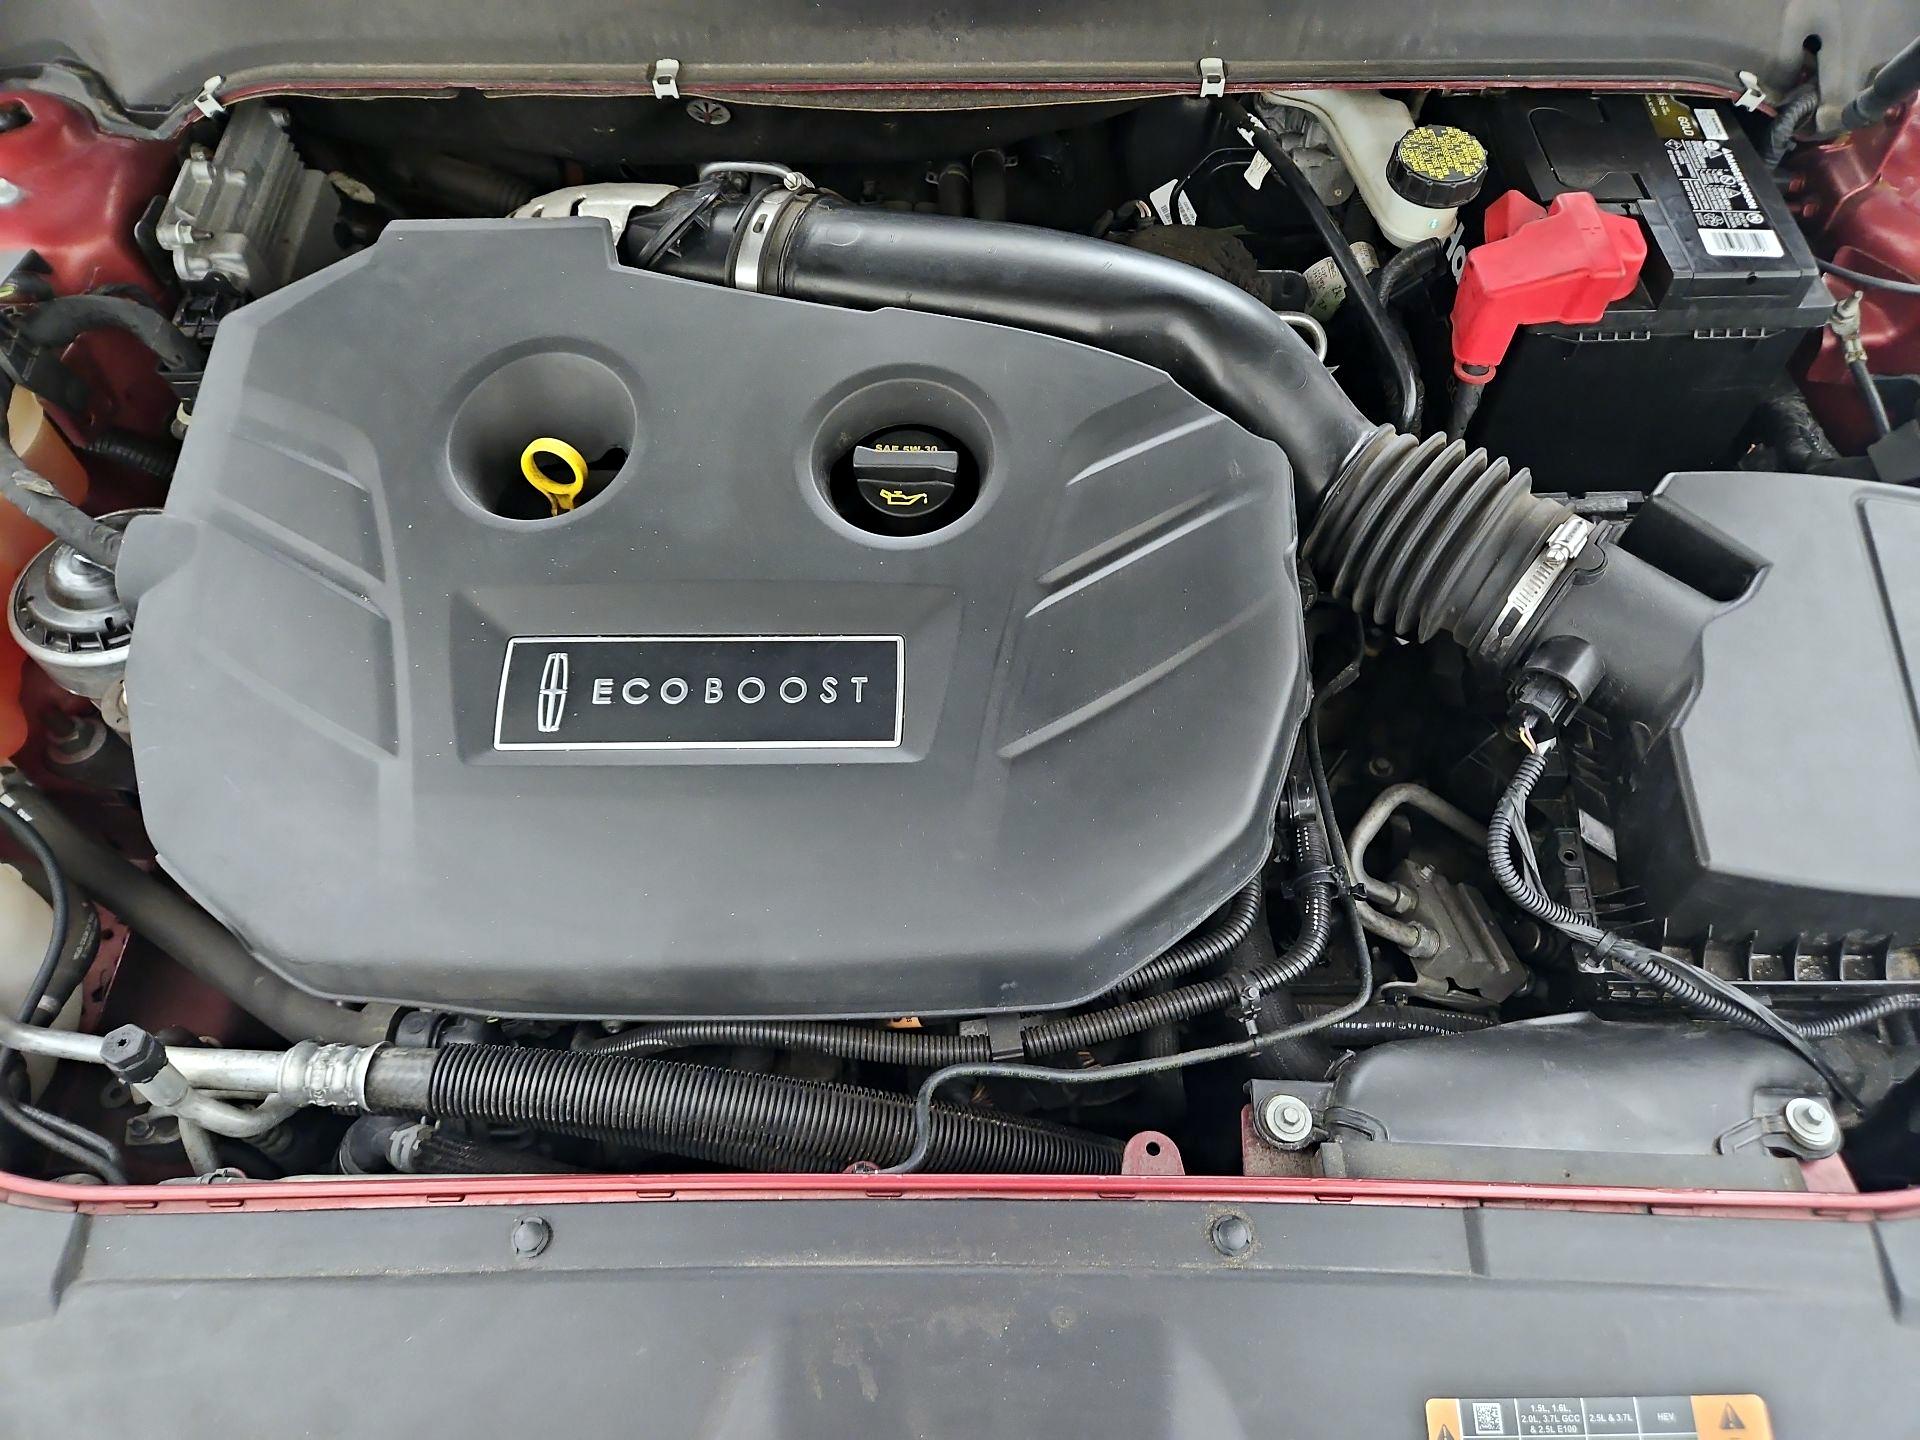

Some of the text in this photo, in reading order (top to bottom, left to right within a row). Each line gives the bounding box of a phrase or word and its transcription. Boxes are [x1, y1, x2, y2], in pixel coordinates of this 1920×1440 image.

[1678, 116, 1694, 137] GOLD
[875, 444, 900, 452] SAE
[592, 676, 869, 705] ECOBOOST
[1530, 1403, 1550, 1413] 1.5L,
[1521, 1414, 1580, 1423] 2.0L, 3.7L GCC
[1588, 1413, 1633, 1422] 2.5L & 3.7L
[1657, 1412, 1674, 1421] HEV
[1530, 1425, 1577, 1433] & 2.5L E100
